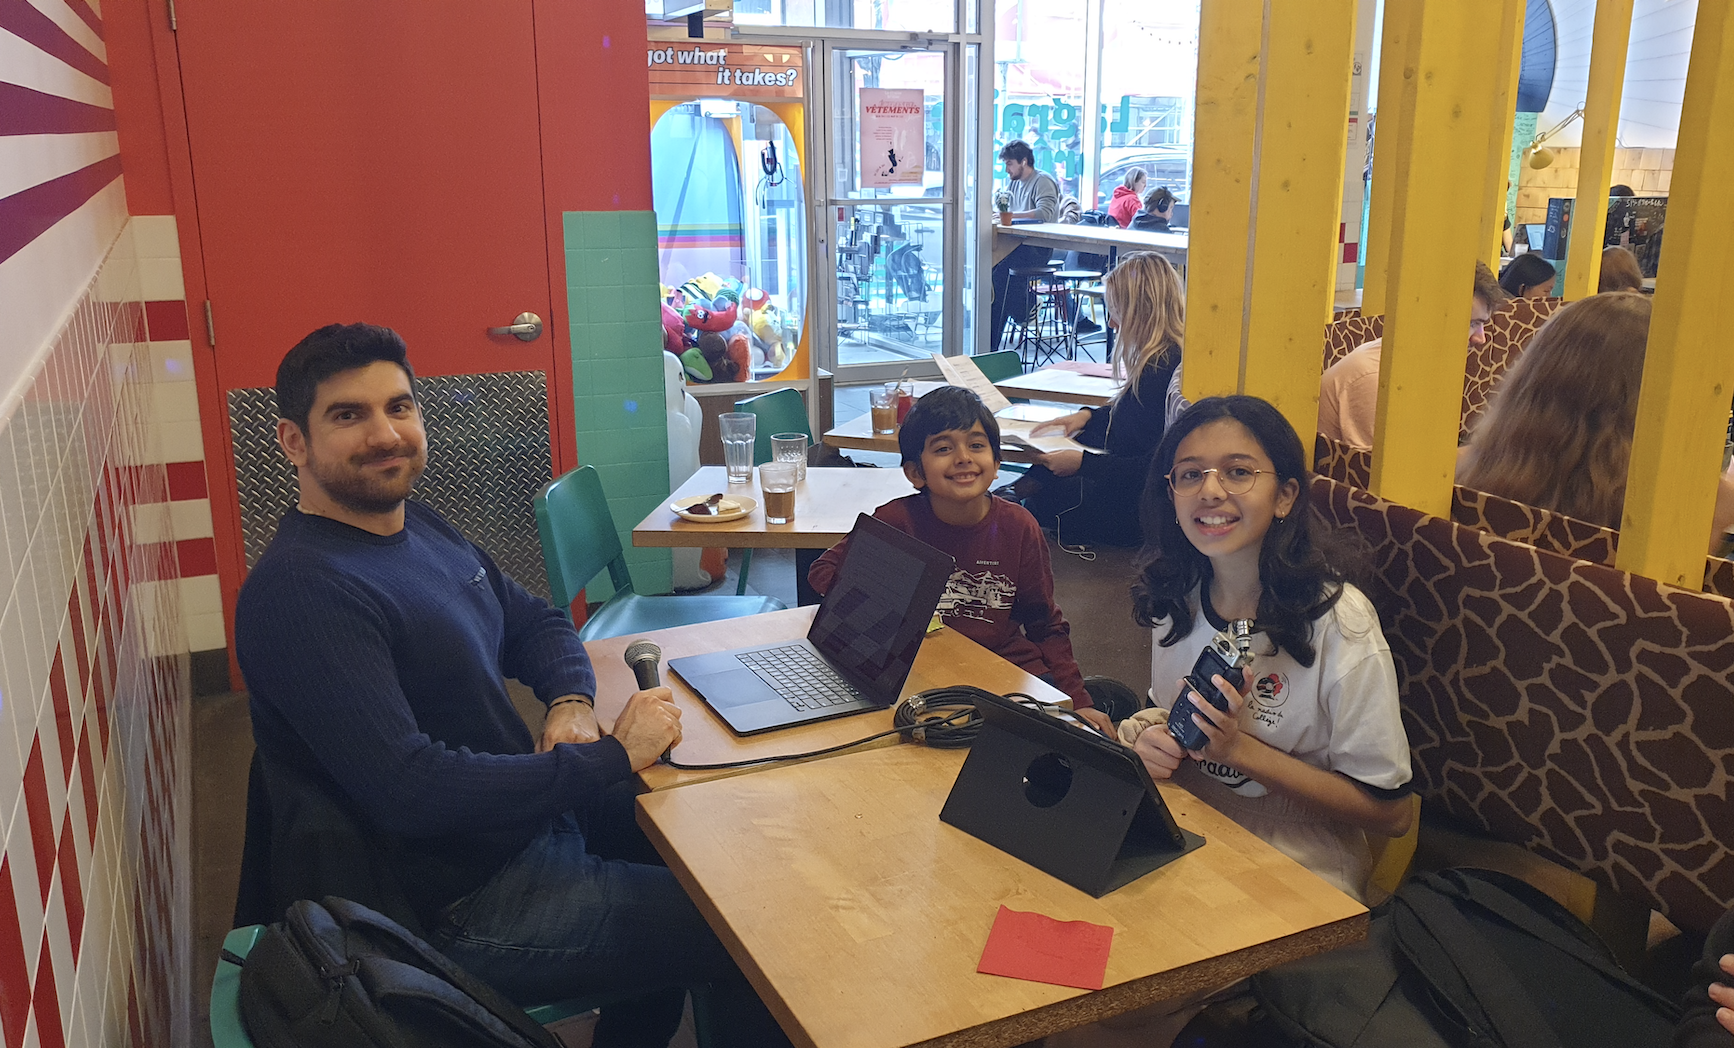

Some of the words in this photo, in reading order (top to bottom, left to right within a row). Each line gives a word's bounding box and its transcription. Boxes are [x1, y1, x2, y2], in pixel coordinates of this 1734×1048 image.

[677, 46, 726, 65] what
[716, 67, 732, 85] it
[734, 67, 798, 87] takes?
[865, 104, 921, 114] VÊTEMENTS
